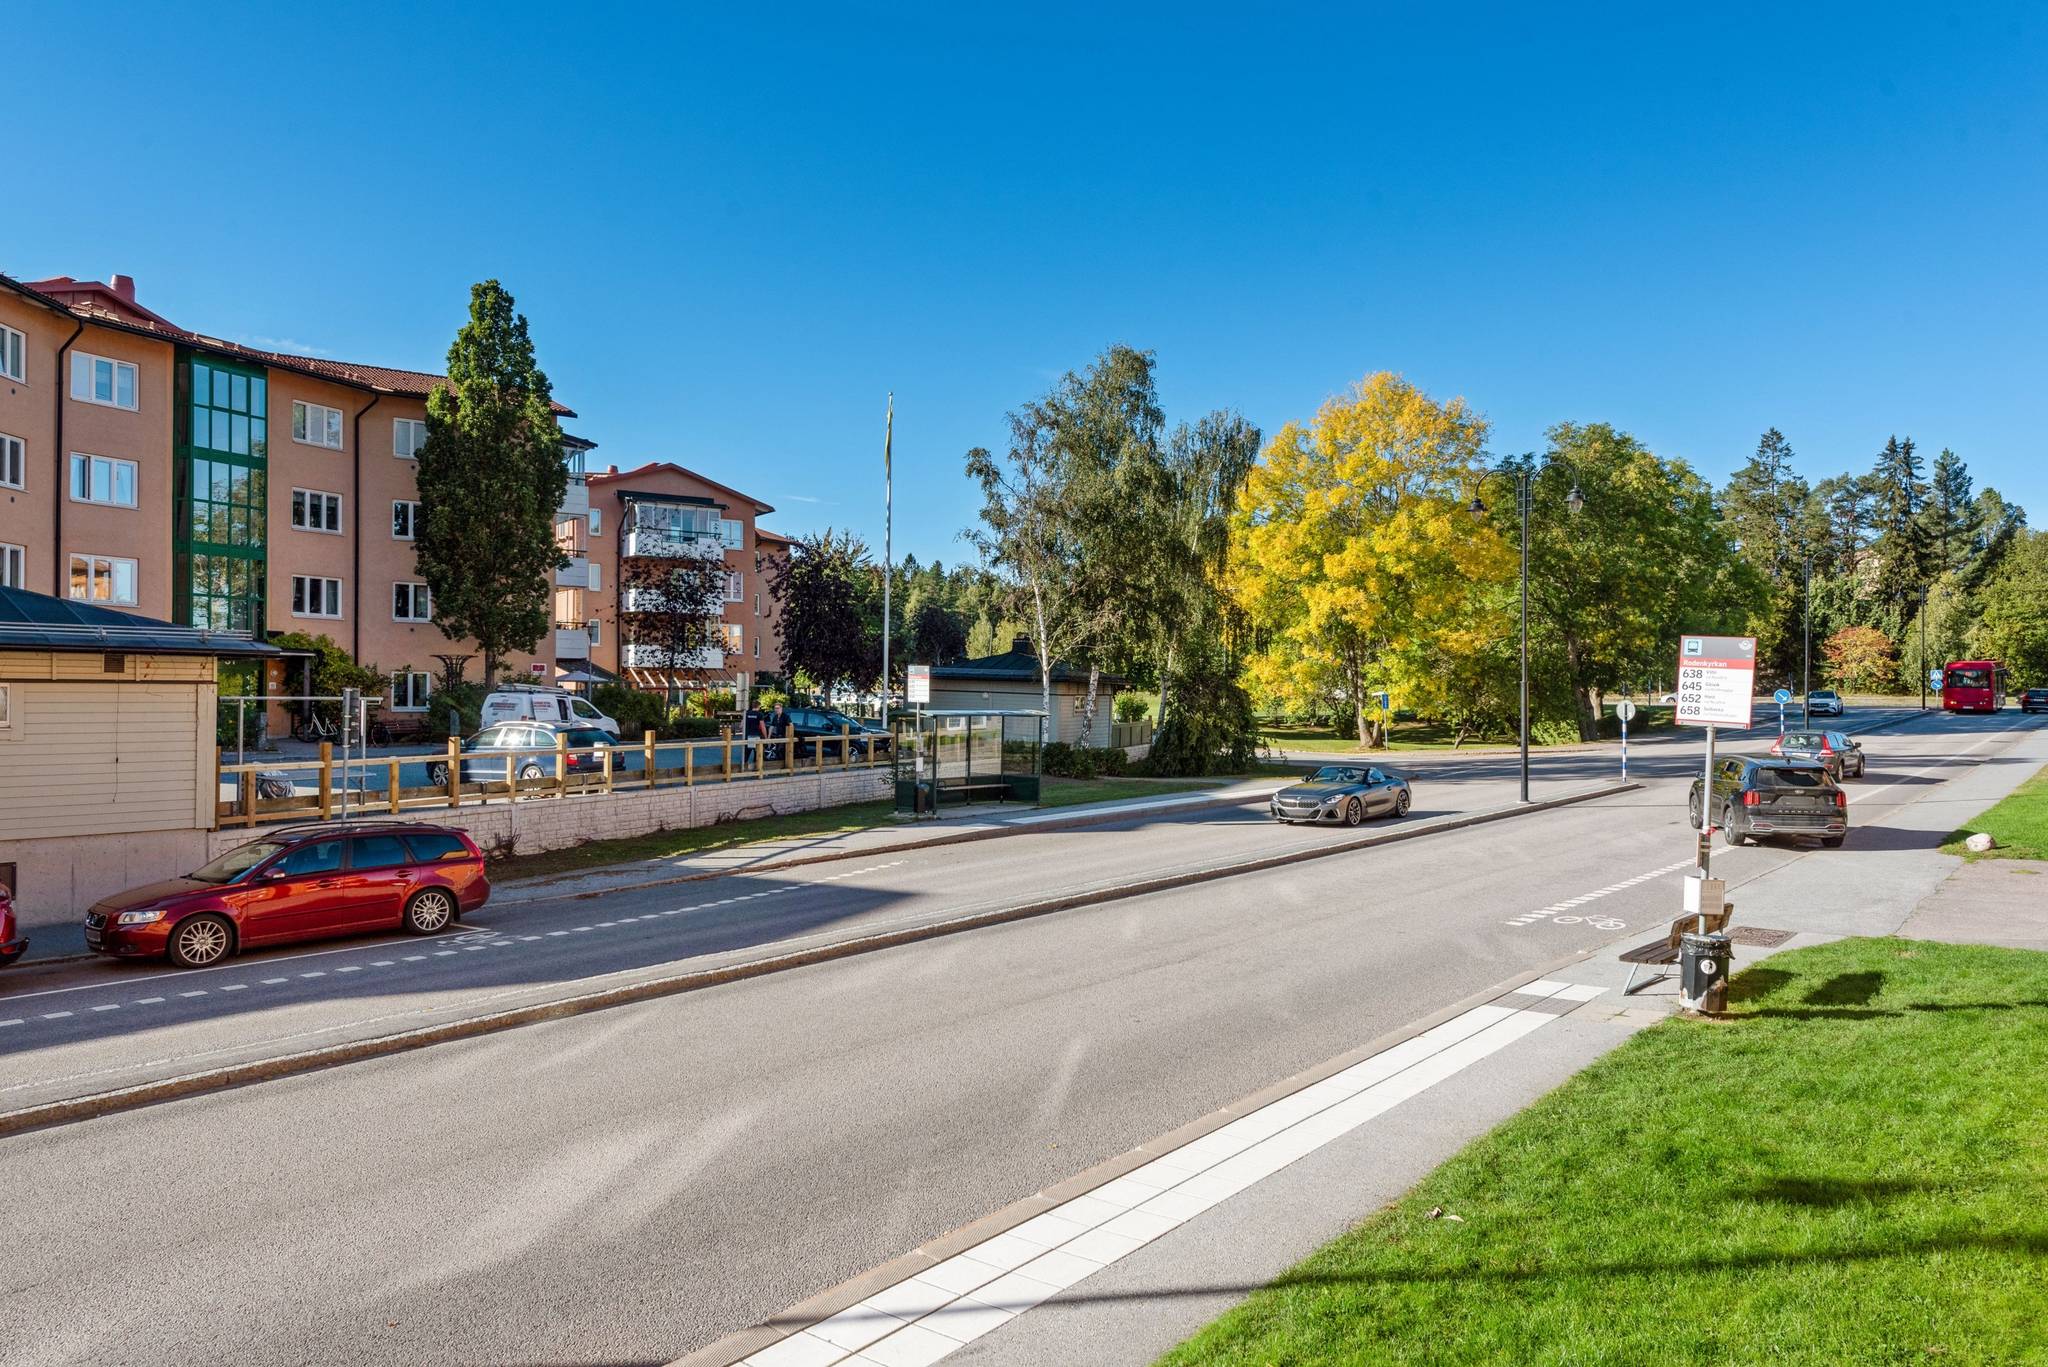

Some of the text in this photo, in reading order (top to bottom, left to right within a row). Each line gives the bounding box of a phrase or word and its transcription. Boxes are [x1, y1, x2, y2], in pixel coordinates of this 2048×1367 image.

[1683, 669, 1703, 679] 638
[1682, 681, 1702, 691] 645
[1682, 694, 1702, 703] 652
[1680, 706, 1700, 715] 658
